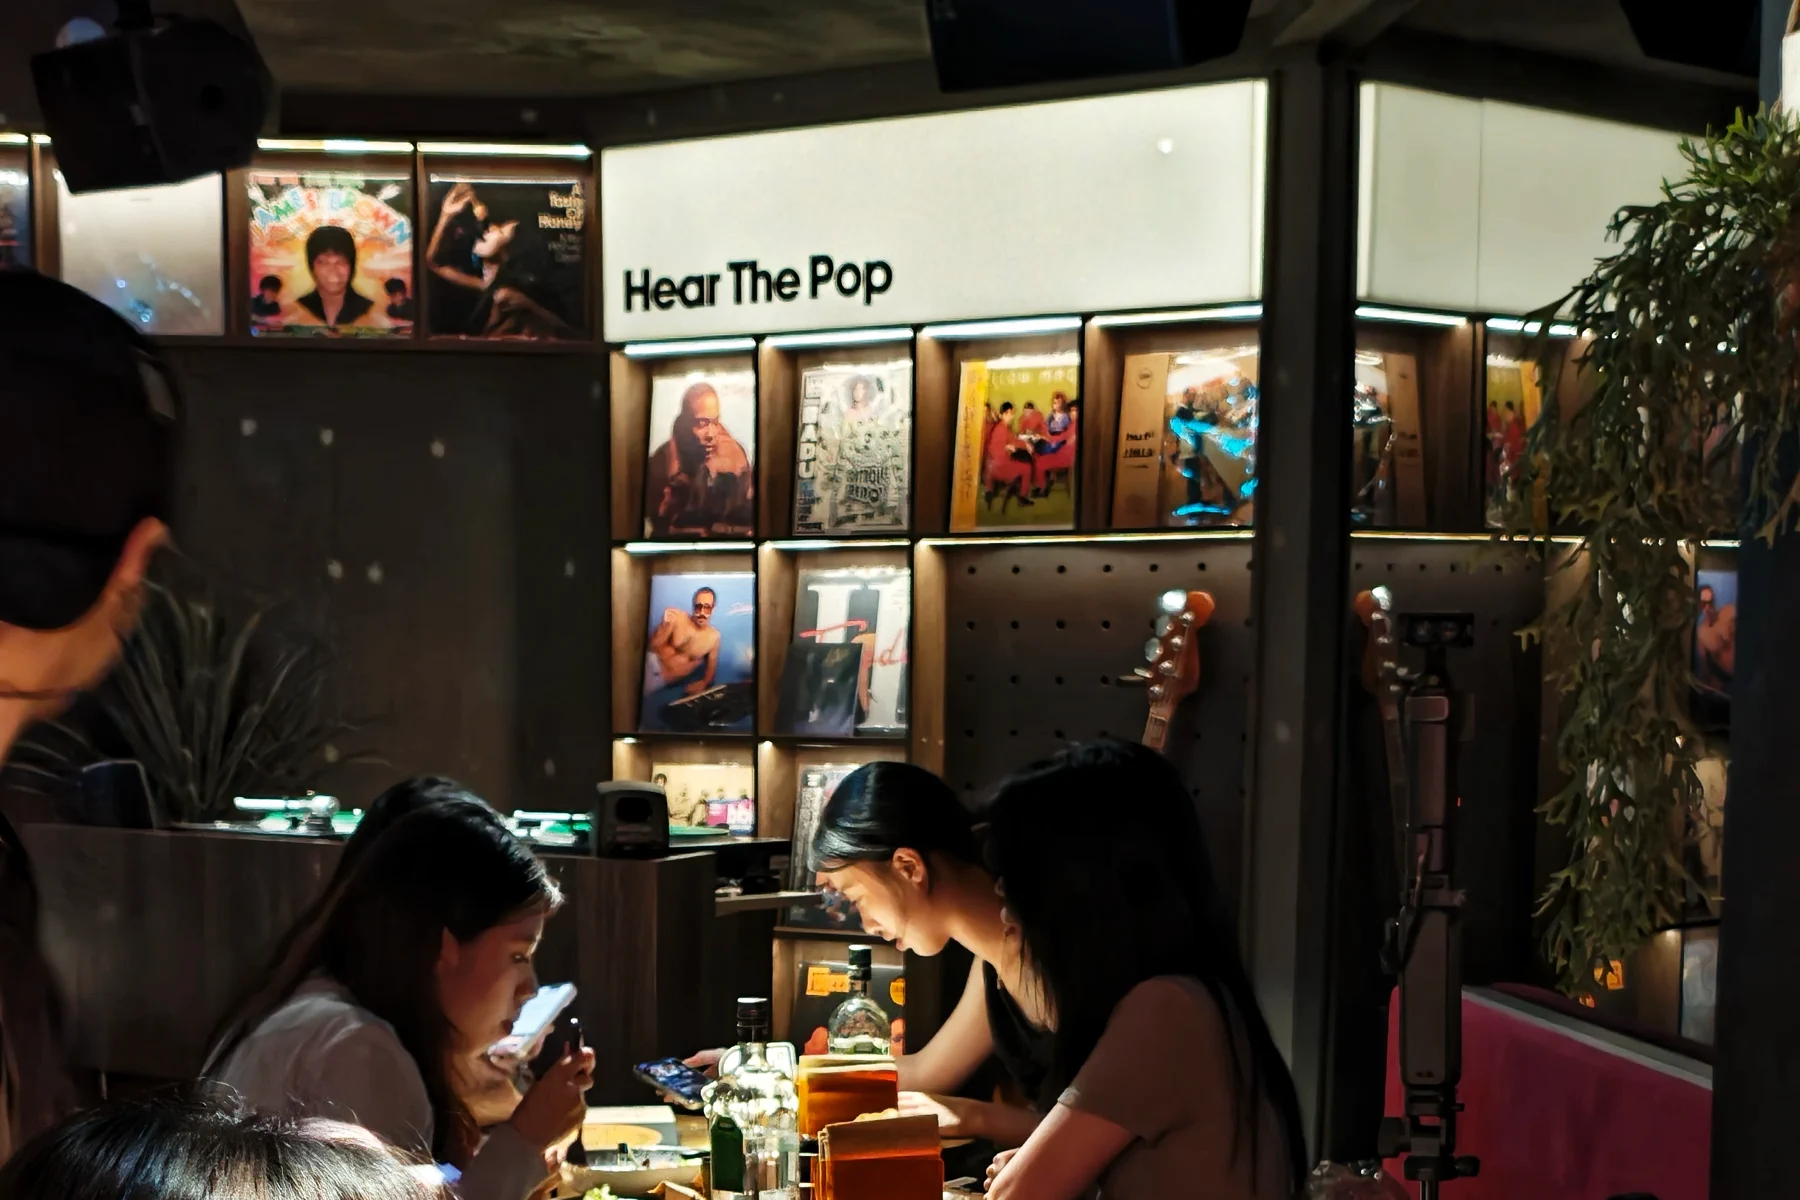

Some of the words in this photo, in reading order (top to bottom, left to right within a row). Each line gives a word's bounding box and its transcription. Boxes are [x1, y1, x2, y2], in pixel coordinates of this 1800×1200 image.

[623, 269, 719, 312] Hear
[727, 260, 800, 305] The
[810, 255, 894, 305] Pop
